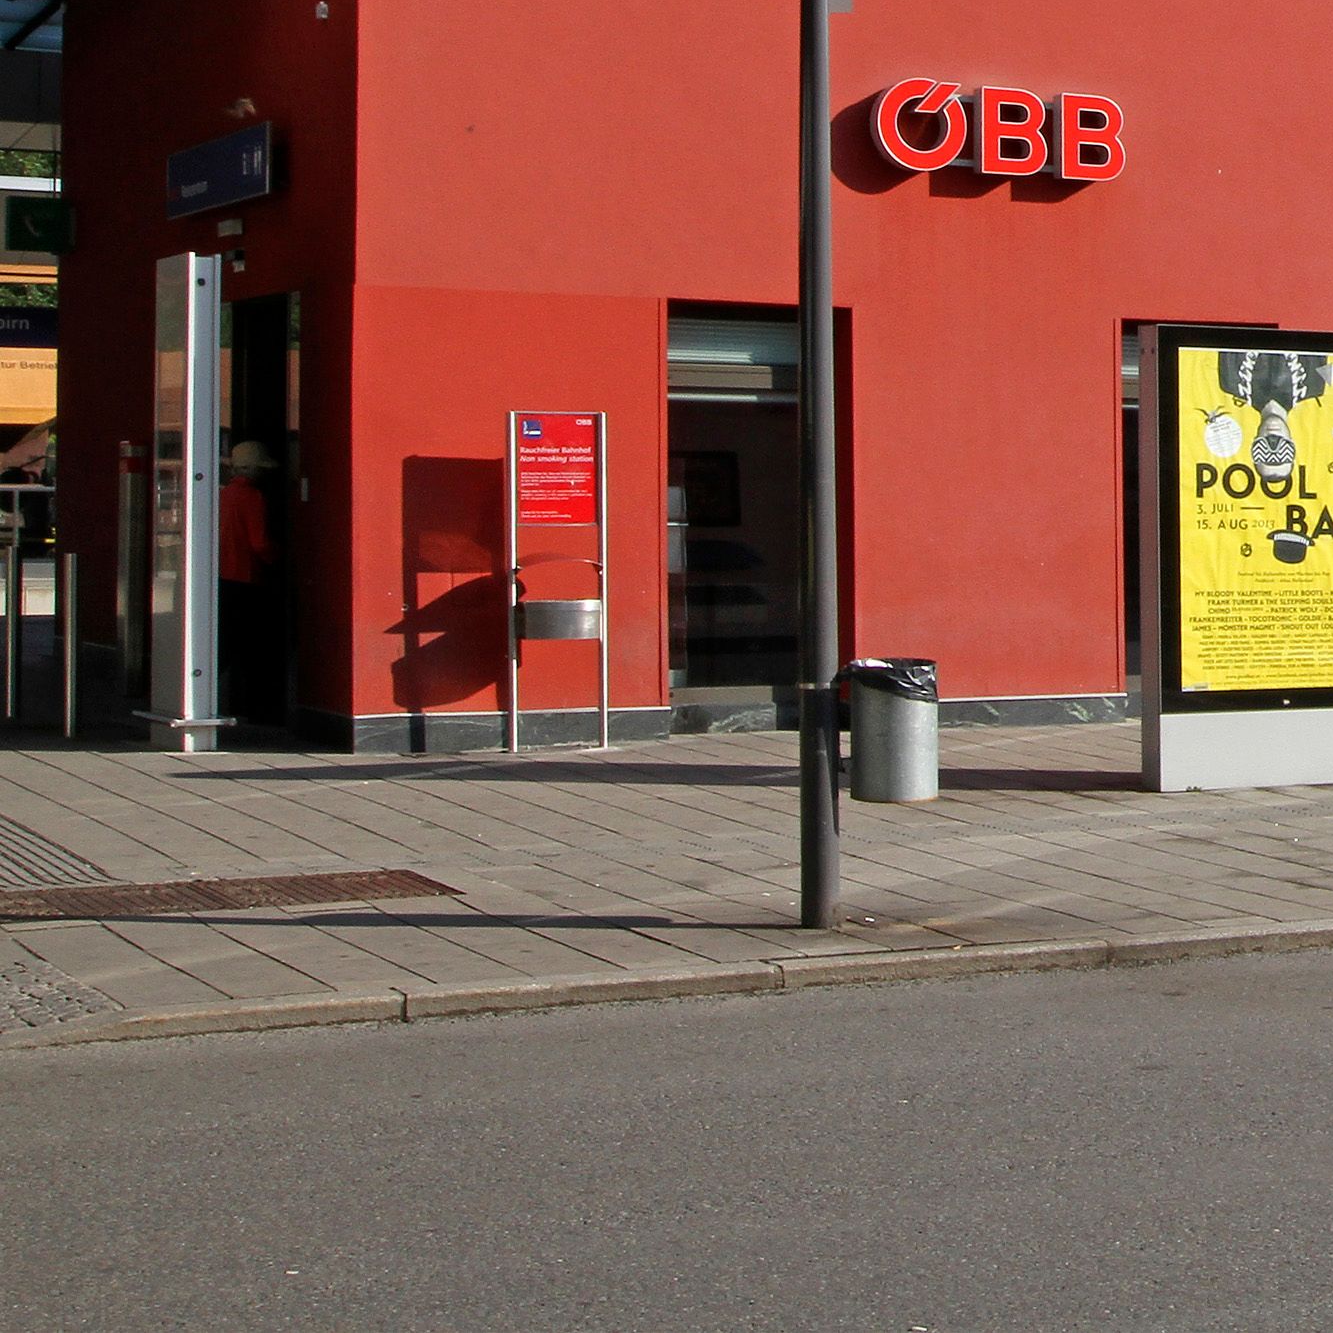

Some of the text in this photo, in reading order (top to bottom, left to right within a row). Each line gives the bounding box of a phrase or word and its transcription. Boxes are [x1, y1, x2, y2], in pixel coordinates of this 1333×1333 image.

[872, 78, 1126, 181] ÖBB
[561, 446, 591, 454] Bahnhof
[537, 455, 567, 464] smoking
[569, 455, 594, 463] station
[1195, 463, 1317, 499] POOL
[1211, 503, 1234, 513] JULI
[1196, 519, 1212, 530] 15.
[1251, 519, 1275, 530] 2013
